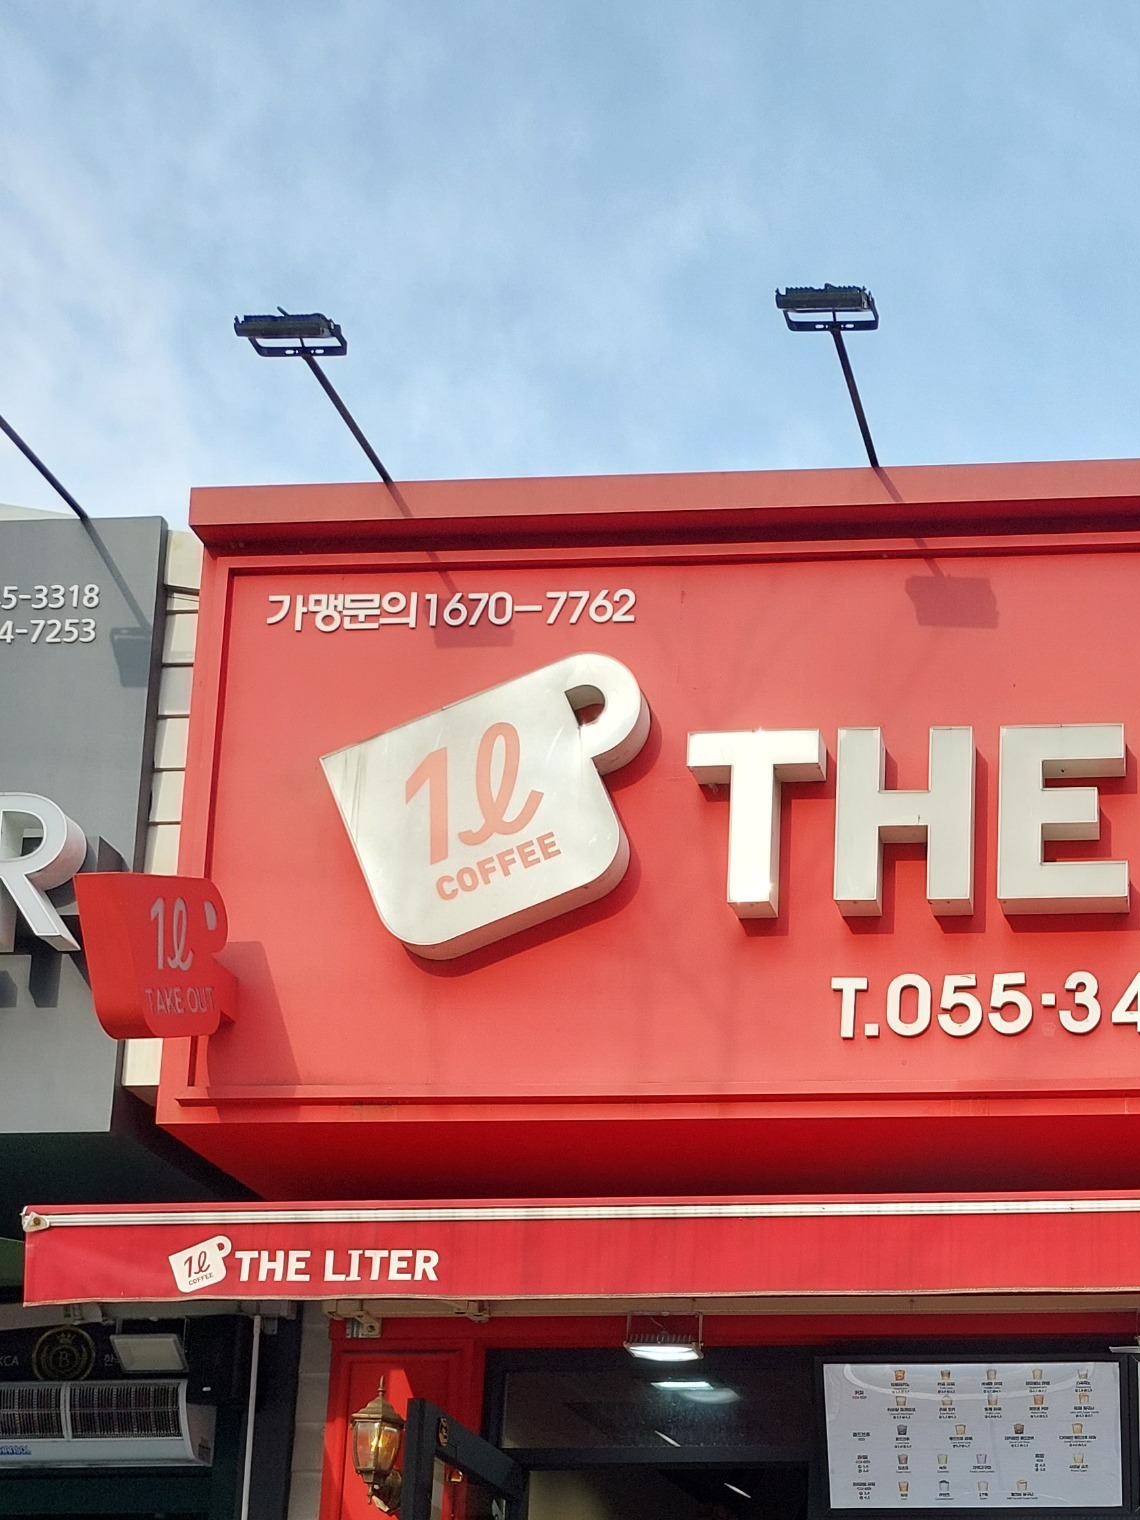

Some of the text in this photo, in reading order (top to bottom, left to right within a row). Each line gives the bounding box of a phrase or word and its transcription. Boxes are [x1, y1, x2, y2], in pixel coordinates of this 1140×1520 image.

[687, 723, 1130, 919] THE
[435, 831, 562, 900] COFFEE
[145, 986, 215, 1014] TAKE OUT
[188, 1272, 214, 1286] COFFEE
[234, 1249, 439, 1282] THE LITER
